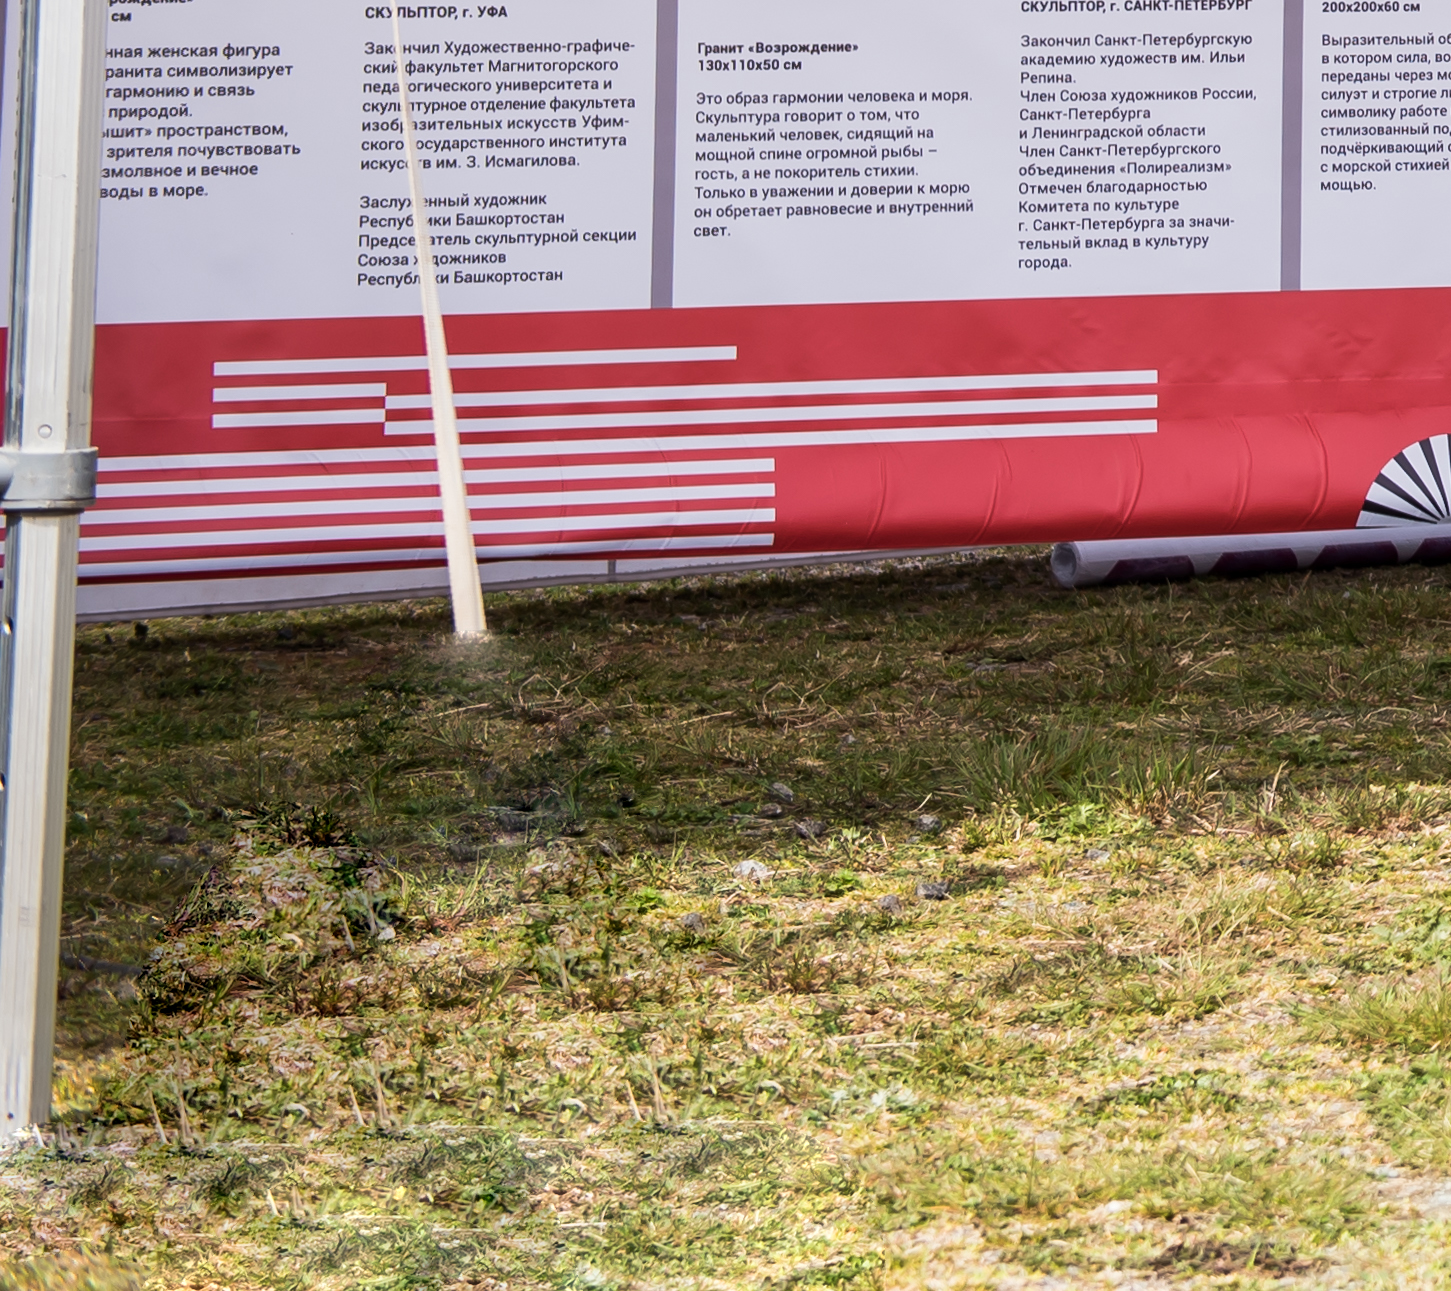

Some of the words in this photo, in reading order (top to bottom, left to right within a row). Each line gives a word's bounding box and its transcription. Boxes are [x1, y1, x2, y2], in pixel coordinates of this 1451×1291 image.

[1403, 3, 1420, 12] см
[698, 42, 744, 57] Гранит
[748, 42, 858, 56] «Возрождение»
[783, 61, 802, 70] см
